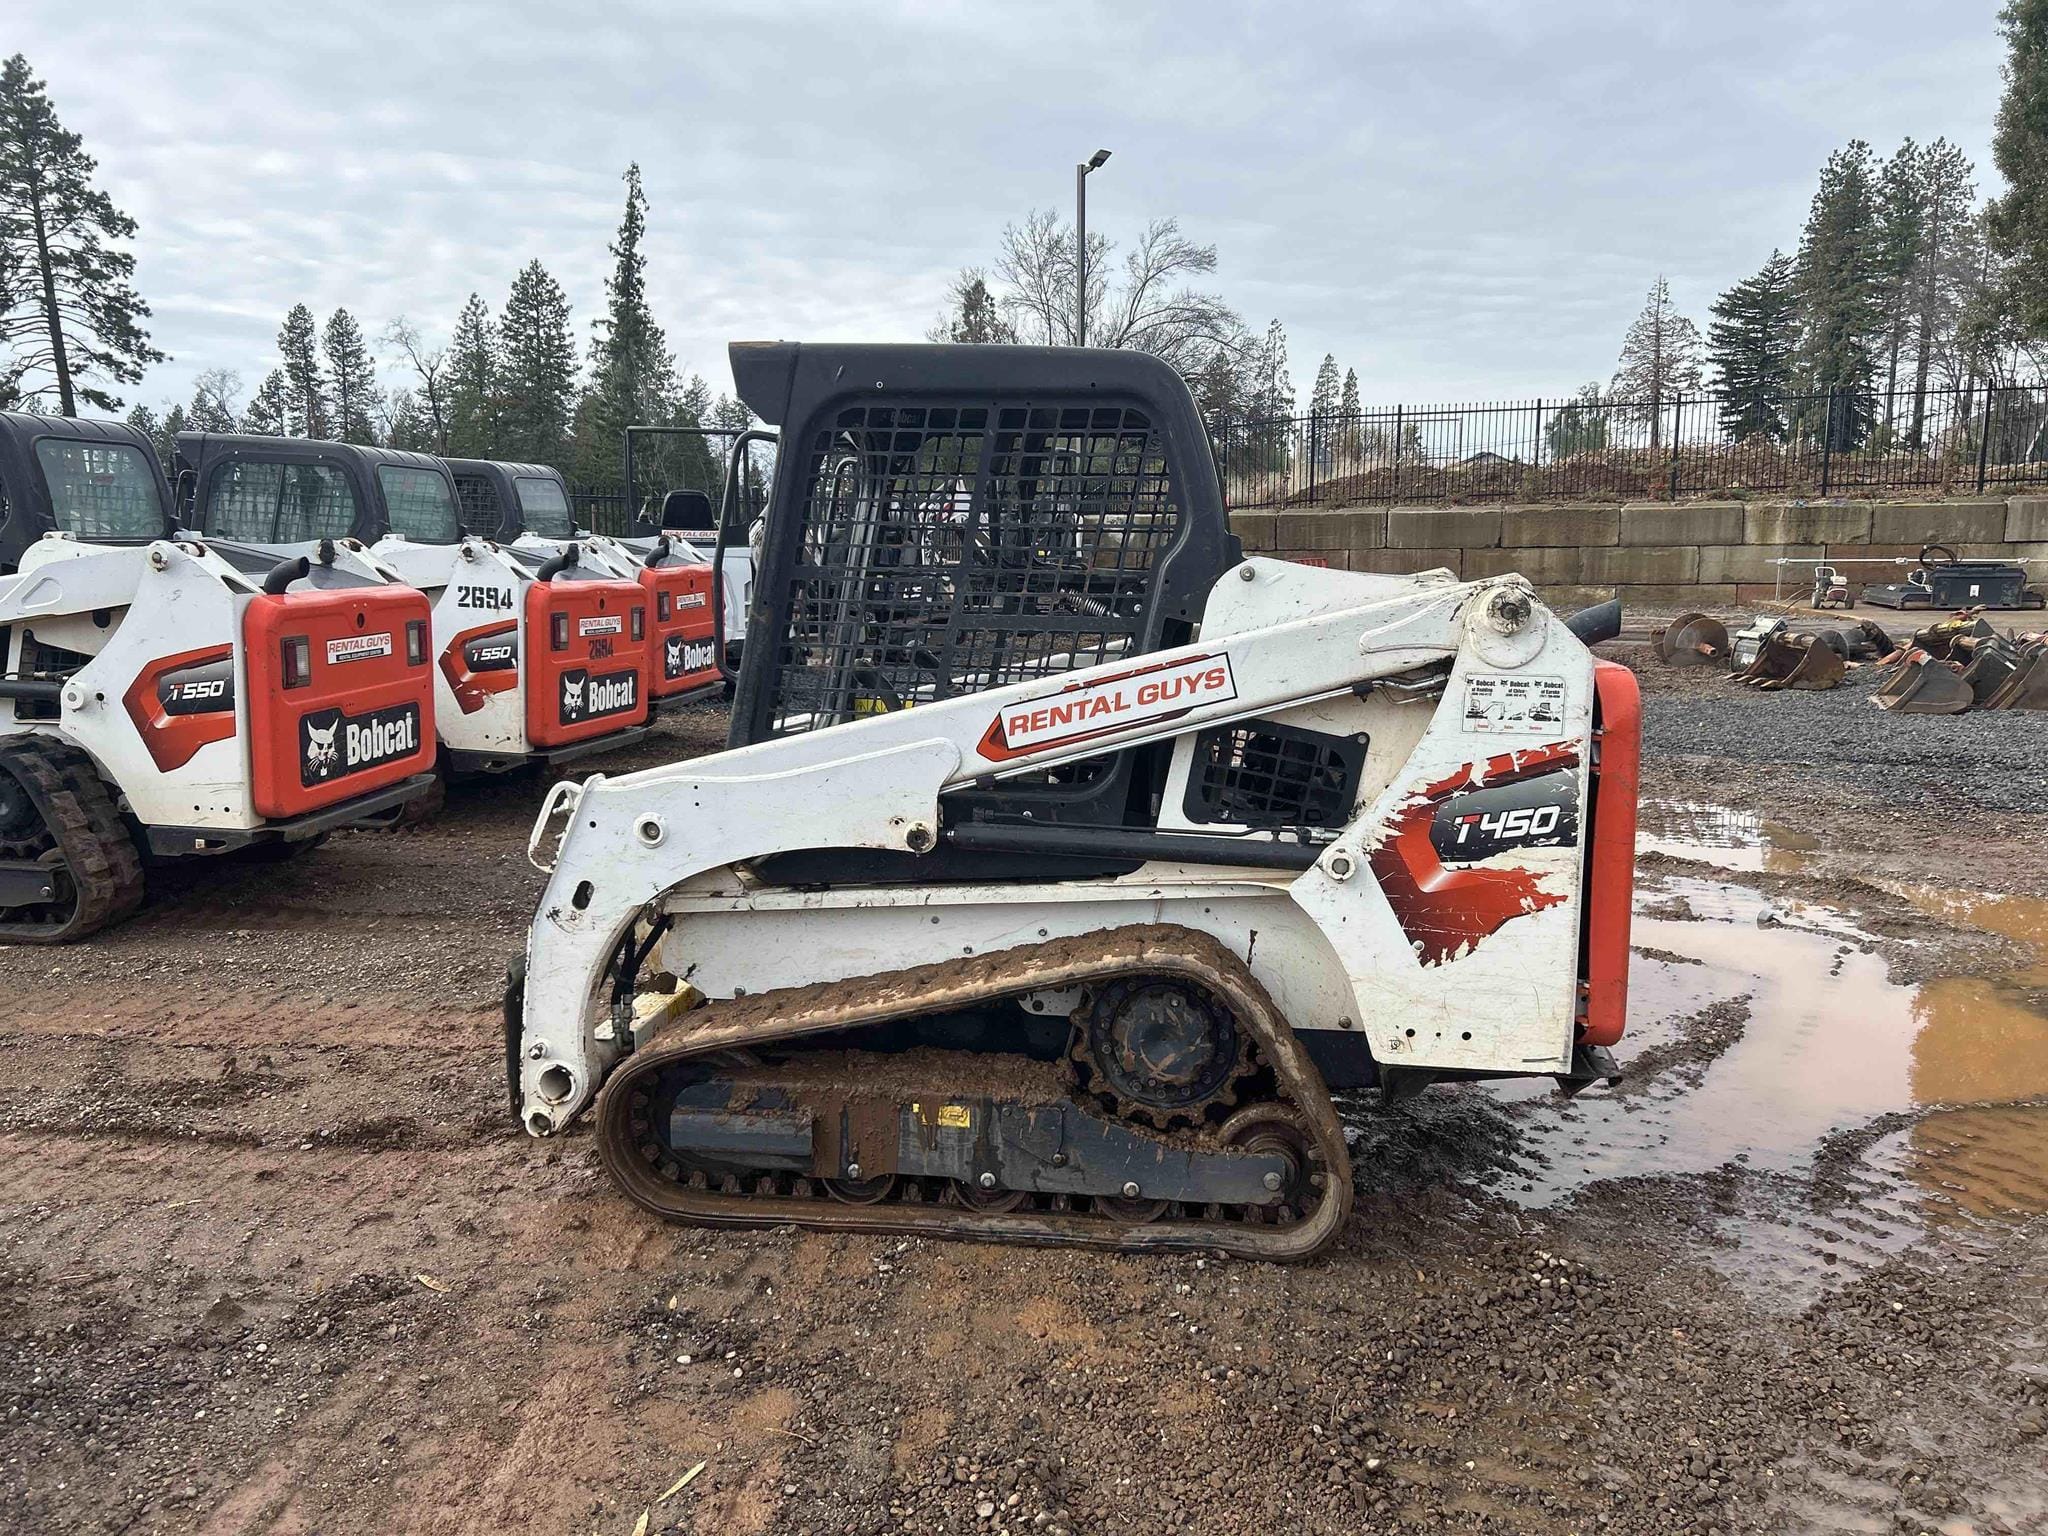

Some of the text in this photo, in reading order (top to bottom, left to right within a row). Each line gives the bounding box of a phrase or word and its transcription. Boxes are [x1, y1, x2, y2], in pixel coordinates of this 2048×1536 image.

[457, 585, 513, 610] 2694
[580, 617, 621, 628] RENTAL GUYS
[328, 635, 390, 653] RENTAL GUYS
[471, 646, 512, 662] T550
[684, 641, 715, 671] Bobcat
[169, 680, 225, 701] T550
[588, 676, 633, 713] Bobcat
[1475, 679, 1496, 687] Bobcat
[1007, 667, 1226, 737] RENTAL GUYS
[346, 711, 414, 766] Bobcat
[1454, 805, 1562, 844] T450
